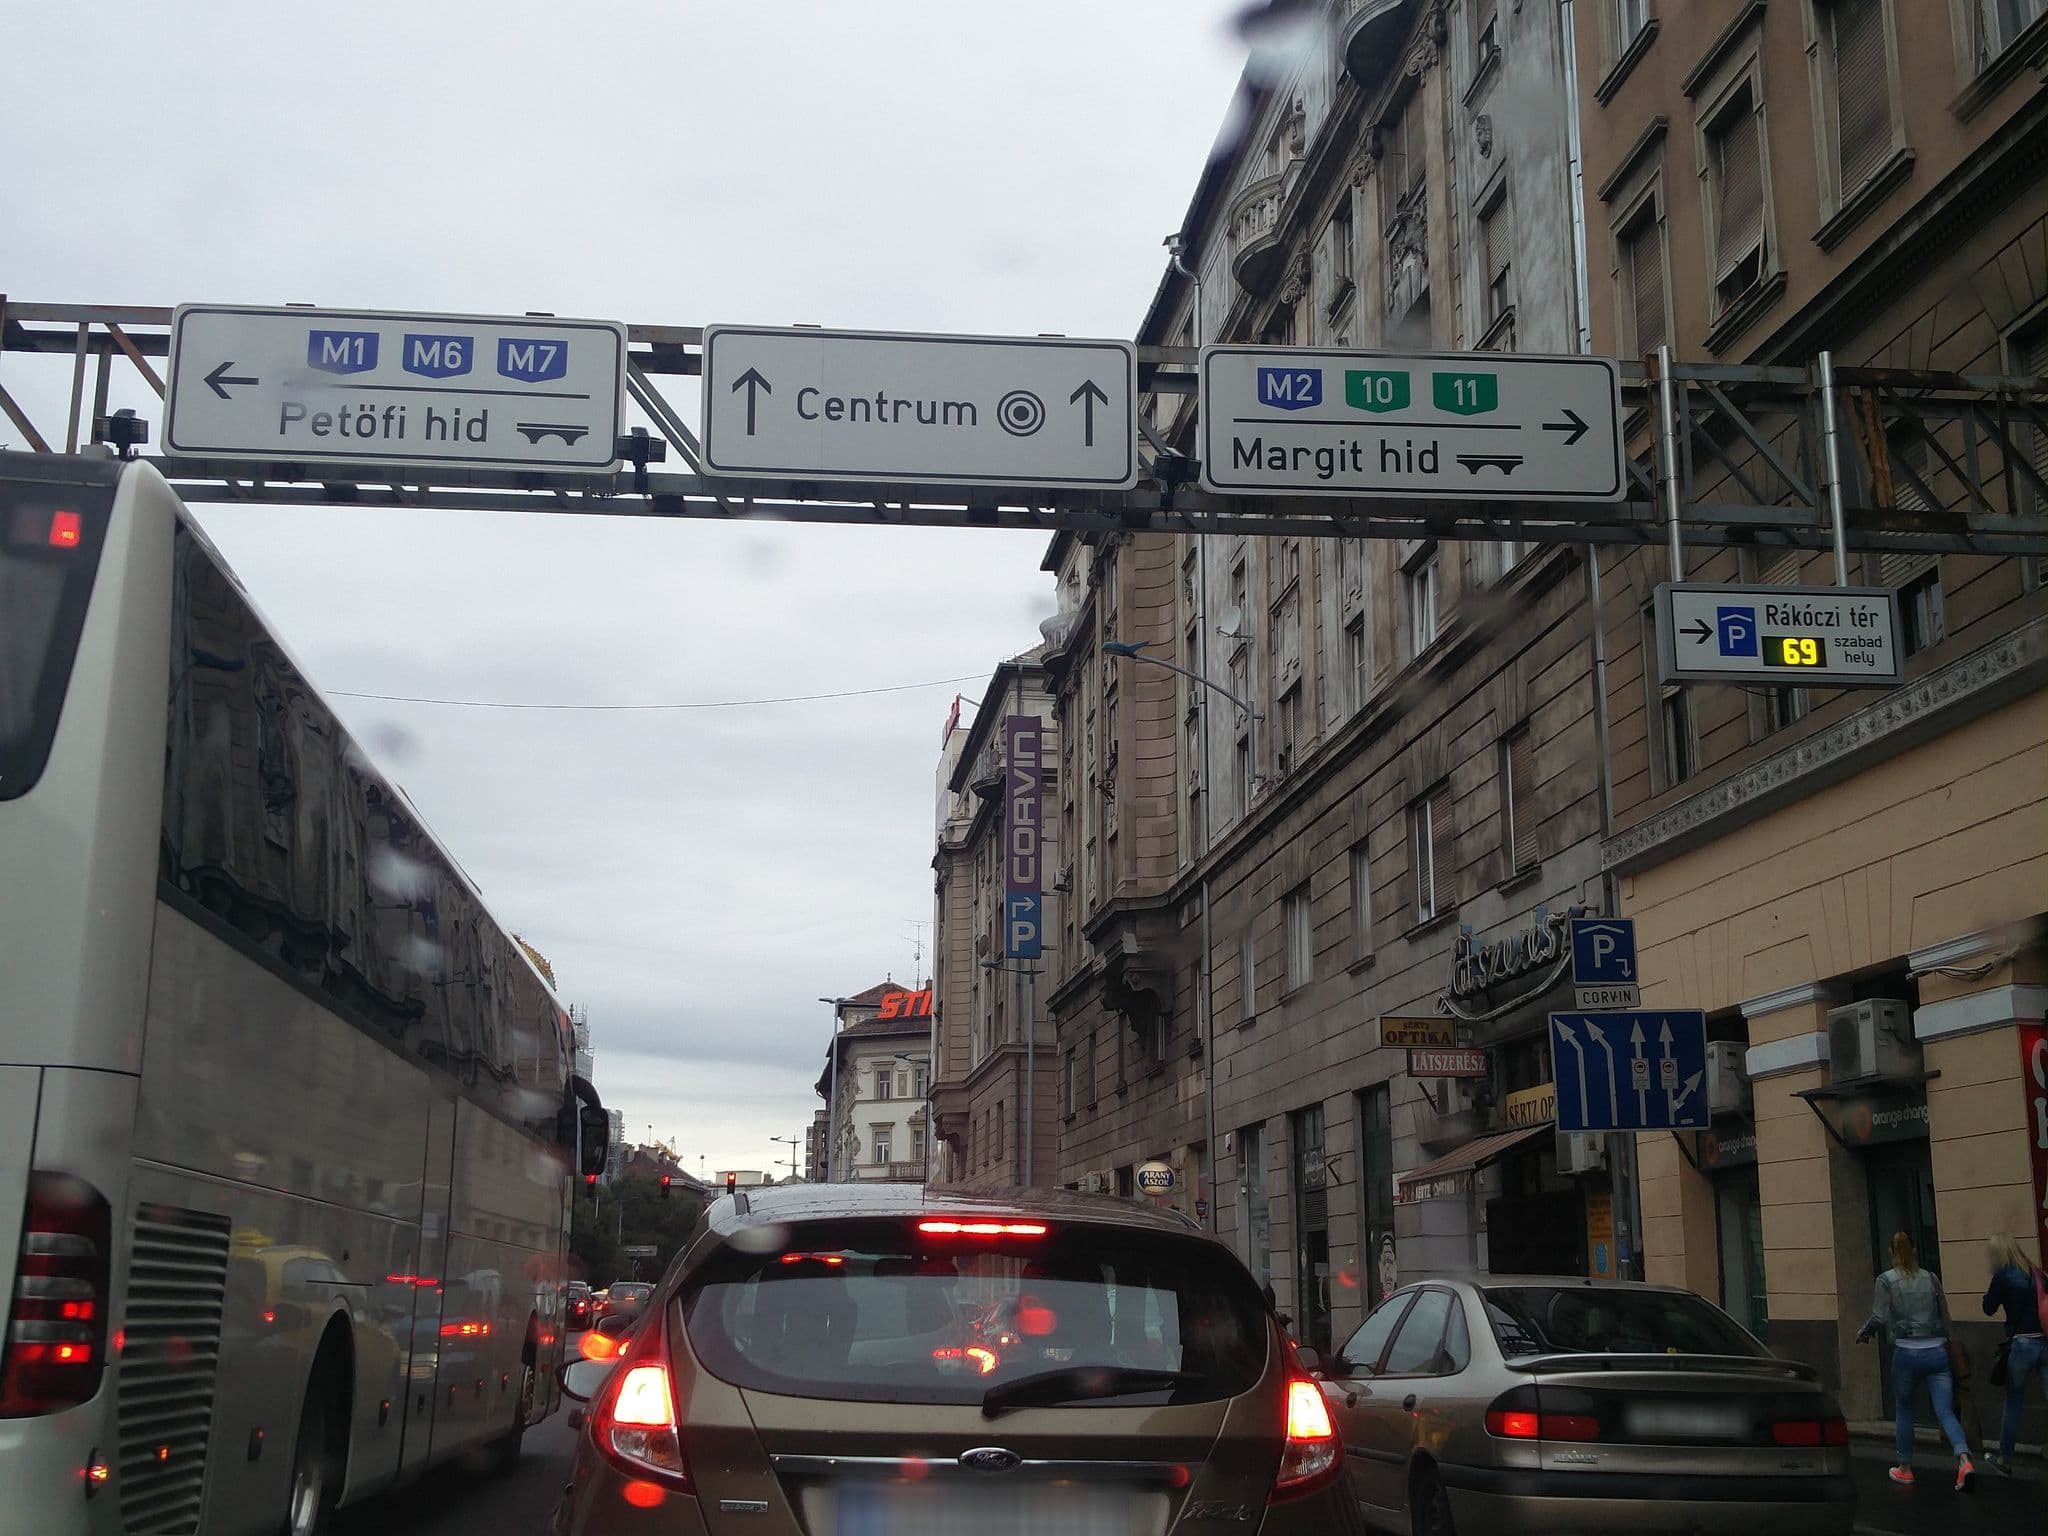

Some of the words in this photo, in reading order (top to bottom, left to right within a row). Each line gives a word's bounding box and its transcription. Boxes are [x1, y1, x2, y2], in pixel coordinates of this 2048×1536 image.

[321, 336, 367, 366] M1
[412, 340, 463, 370] M6
[506, 344, 558, 374] M7
[1266, 373, 1314, 402] M2
[1361, 375, 1394, 404] 10
[1453, 379, 1478, 407] 11
[797, 386, 978, 426] Centrum
[1232, 437, 1363, 481] Margit
[1765, 602, 1840, 628] Rákóczi
[1849, 605, 1879, 629] tér
[1727, 625, 1746, 649] P
[1834, 635, 1882, 649] szabad
[1782, 638, 1817, 665] 69
[1844, 650, 1875, 667] hely
[1013, 731, 1036, 884] CORVIN
[1011, 920, 1036, 952] P
[1592, 933, 1615, 969] P
[879, 990, 932, 1019] STI
[1582, 990, 1632, 1005] CORVIN
[1385, 1030, 1452, 1045] OPTIKA
[1412, 1051, 1488, 1072] LÁTSZERÉSZ
[1508, 1096, 1540, 1127] SÉRTZ
[1143, 1171, 1171, 1179] ARANY
